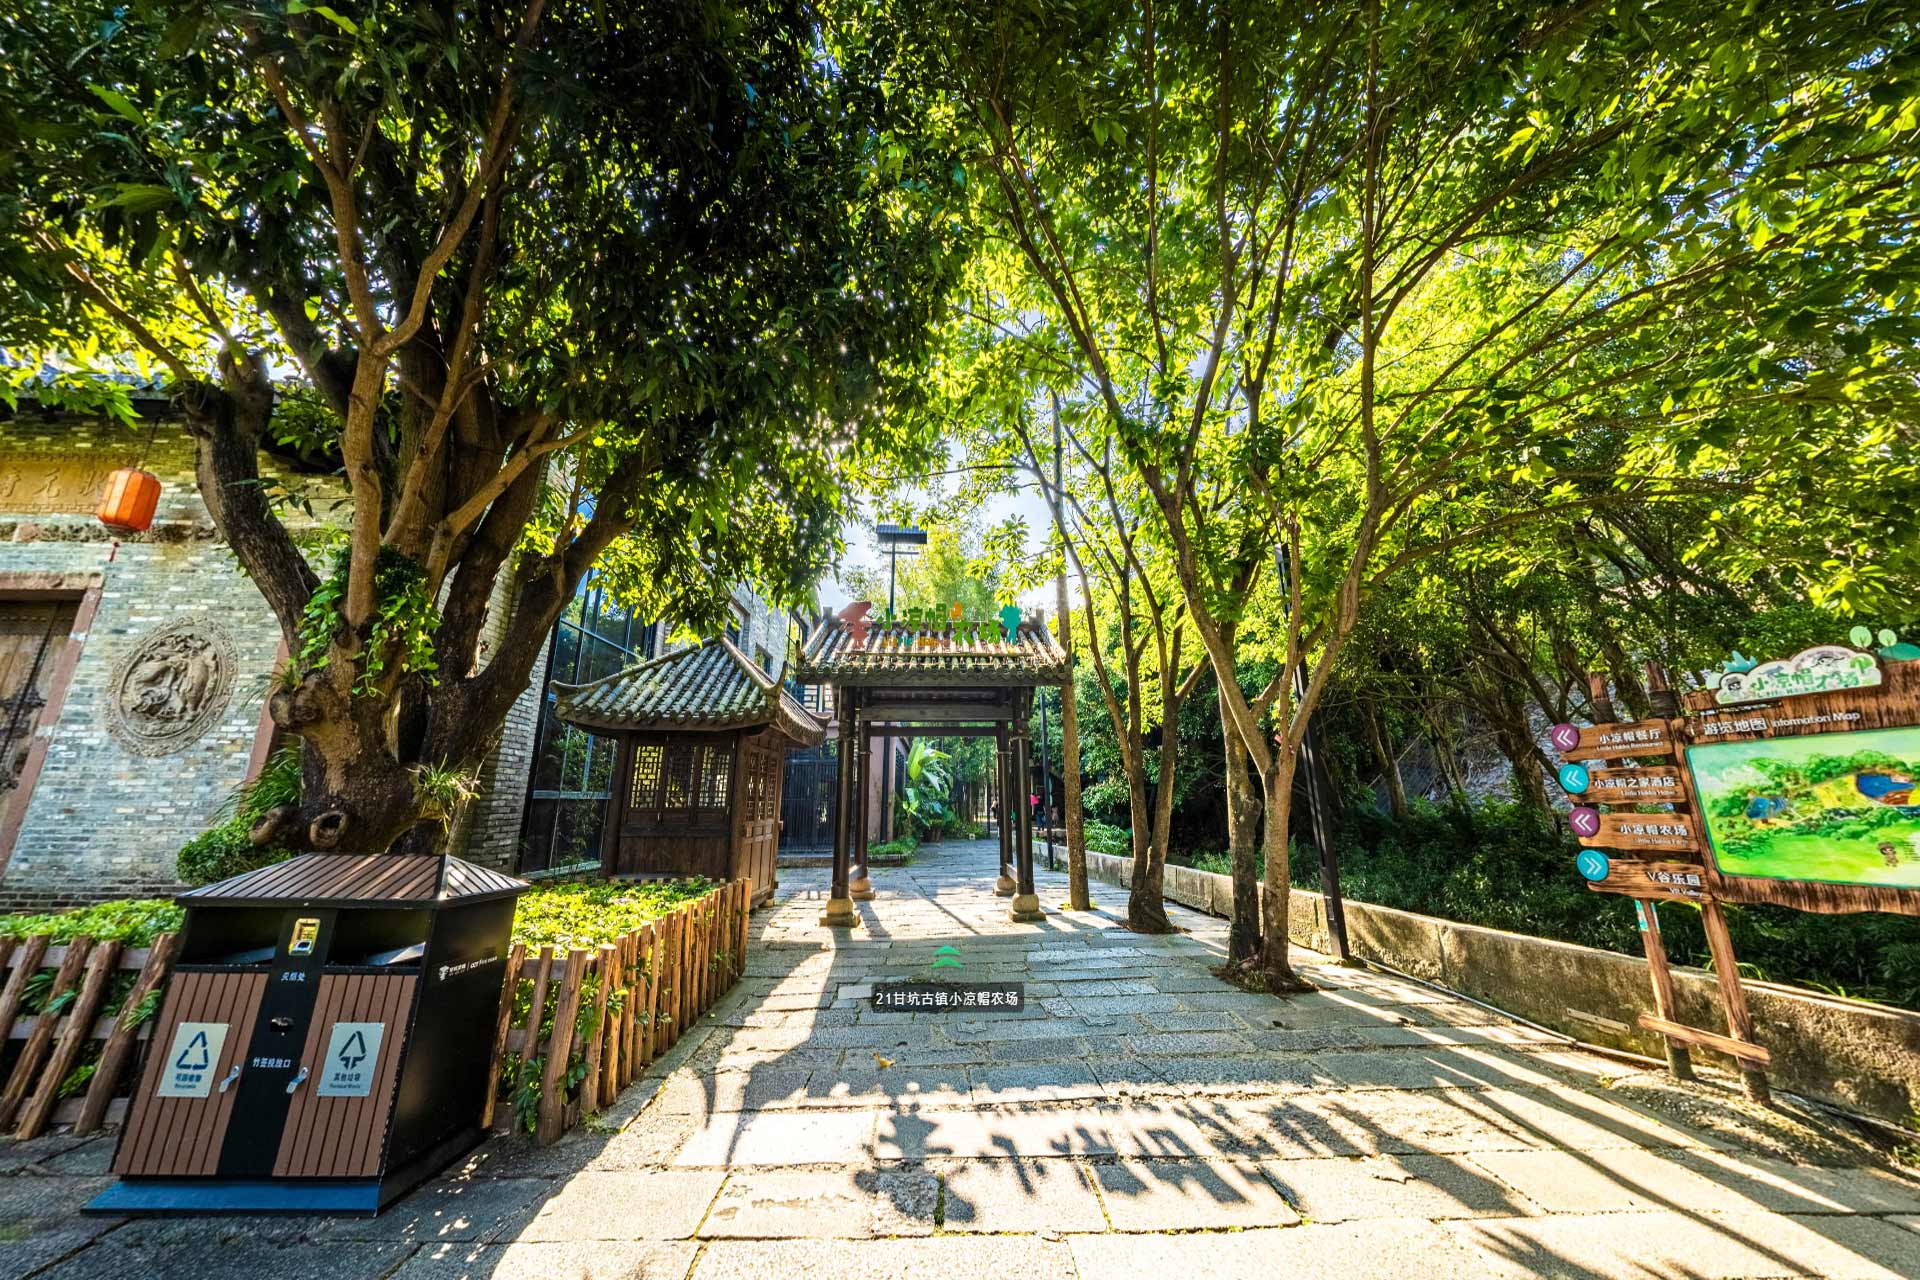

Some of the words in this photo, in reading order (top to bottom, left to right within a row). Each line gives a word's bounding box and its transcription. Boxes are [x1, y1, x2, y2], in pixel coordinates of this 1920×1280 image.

[876, 602, 1000, 646] 小凉帽农场
[1703, 716, 1768, 735] 游览地图
[1771, 714, 1831, 728] Information
[1832, 711, 1861, 724] Map
[1600, 728, 1661, 744] 小凉帽餐厅
[1594, 776, 1675, 789] 小凉帽之家酒店
[1620, 824, 1688, 836] 小凉帽农场
[252, 1056, 292, 1069] 竹签投放口
[333, 1072, 361, 1082] 其他垃圾
